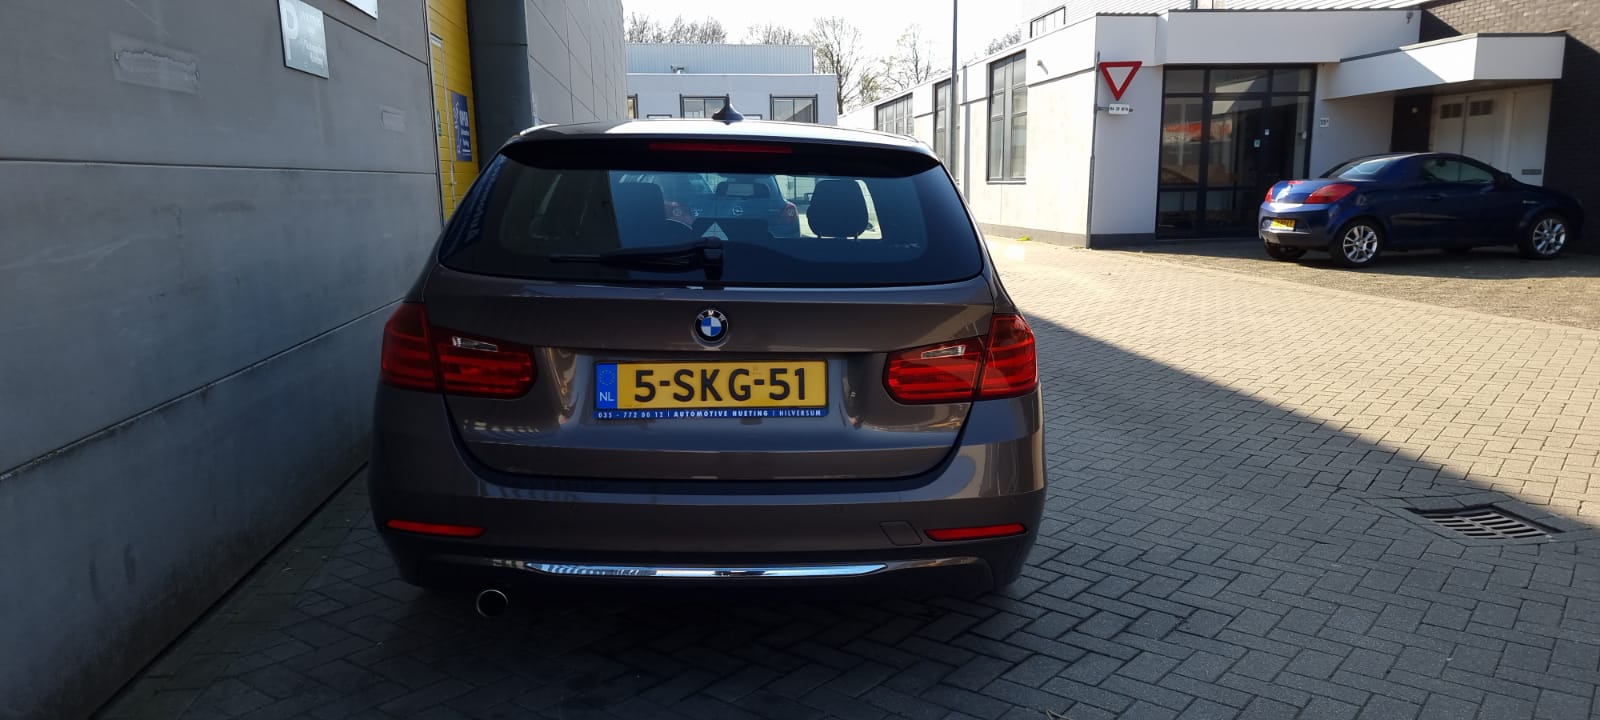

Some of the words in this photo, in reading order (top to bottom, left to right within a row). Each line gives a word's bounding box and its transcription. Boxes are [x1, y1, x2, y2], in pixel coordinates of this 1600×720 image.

[284, 4, 298, 60] P
[696, 309, 727, 322] BMW
[634, 368, 805, 402] 5-SKG-51
[599, 392, 615, 402] NL
[598, 411, 612, 419] 035
